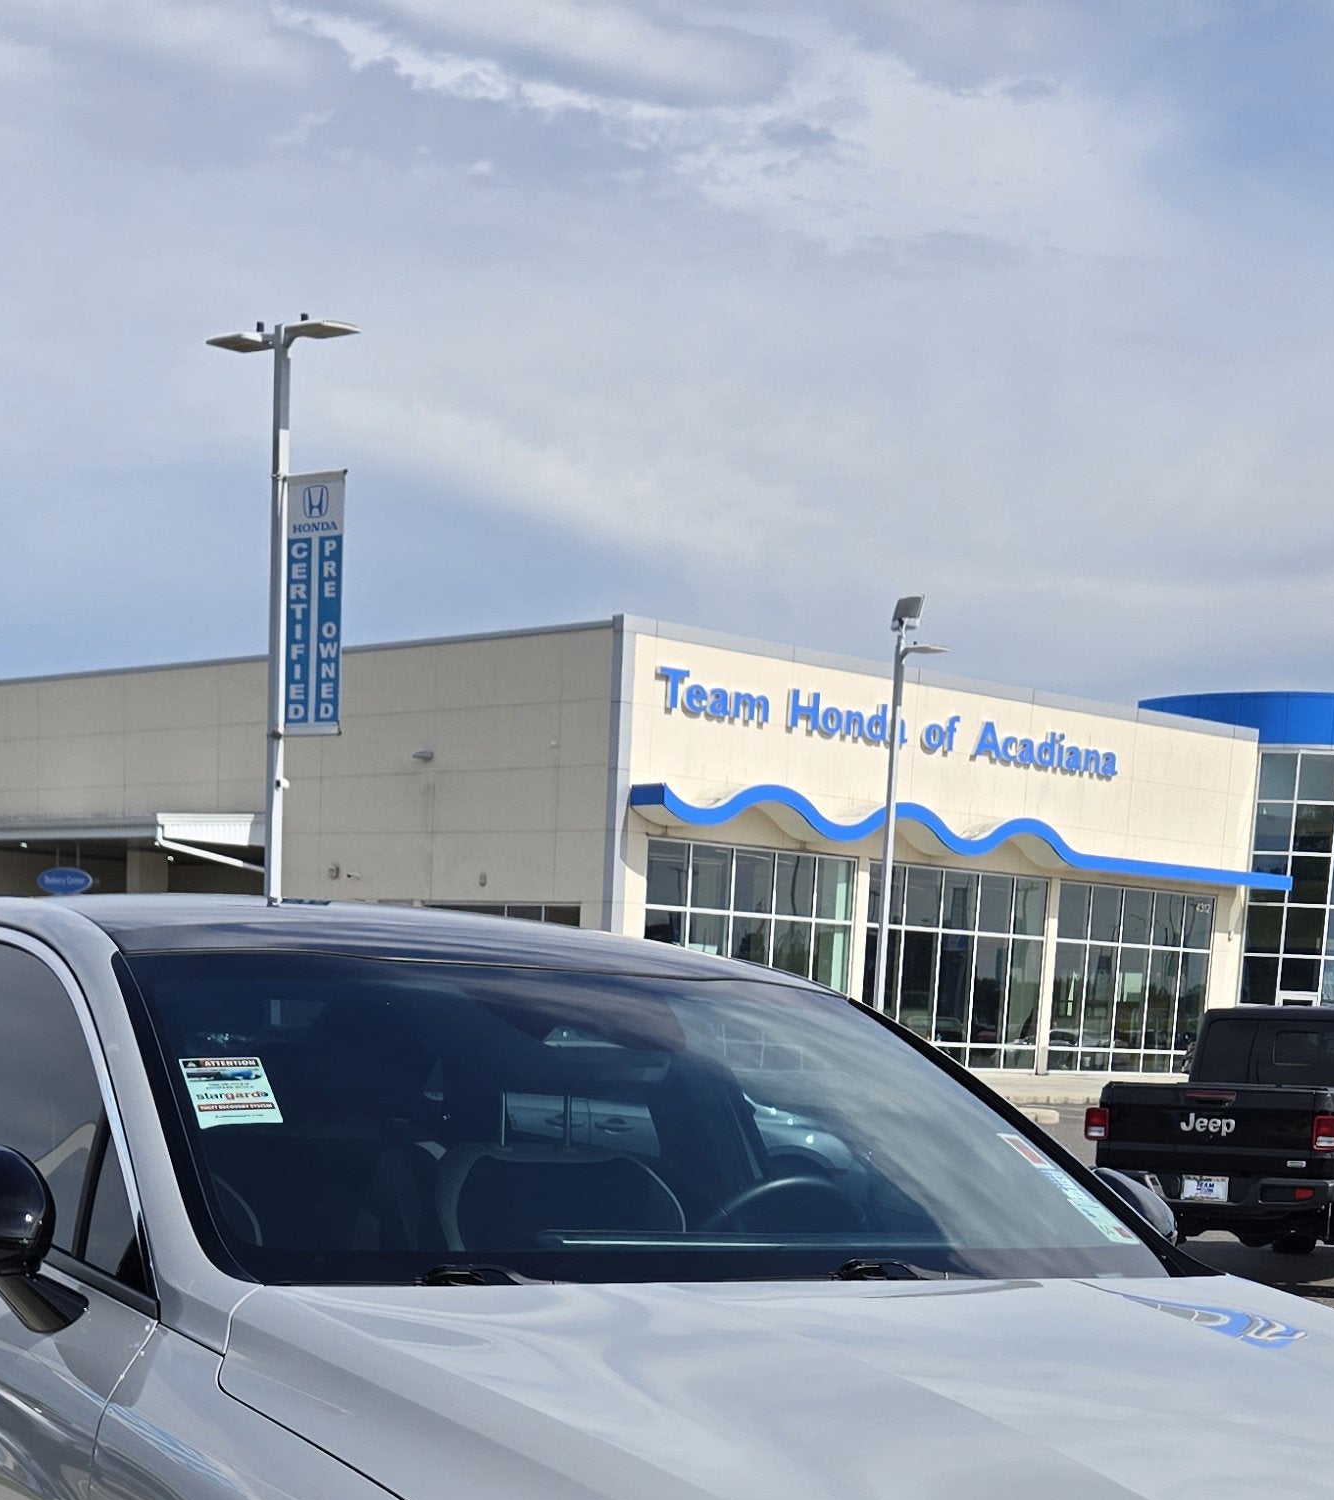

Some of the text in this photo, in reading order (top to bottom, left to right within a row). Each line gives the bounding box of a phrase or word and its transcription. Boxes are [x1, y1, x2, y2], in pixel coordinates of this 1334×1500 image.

[292, 521, 338, 534] HONDA
[288, 541, 309, 720] CERTIFIED
[319, 539, 338, 719] PRE OWNED
[656, 665, 770, 724] Team
[922, 715, 961, 753] of
[973, 720, 1118, 777] Acadiana
[204, 1059, 256, 1067] ATTENTION
[1180, 1112, 1236, 1137] Jeep
